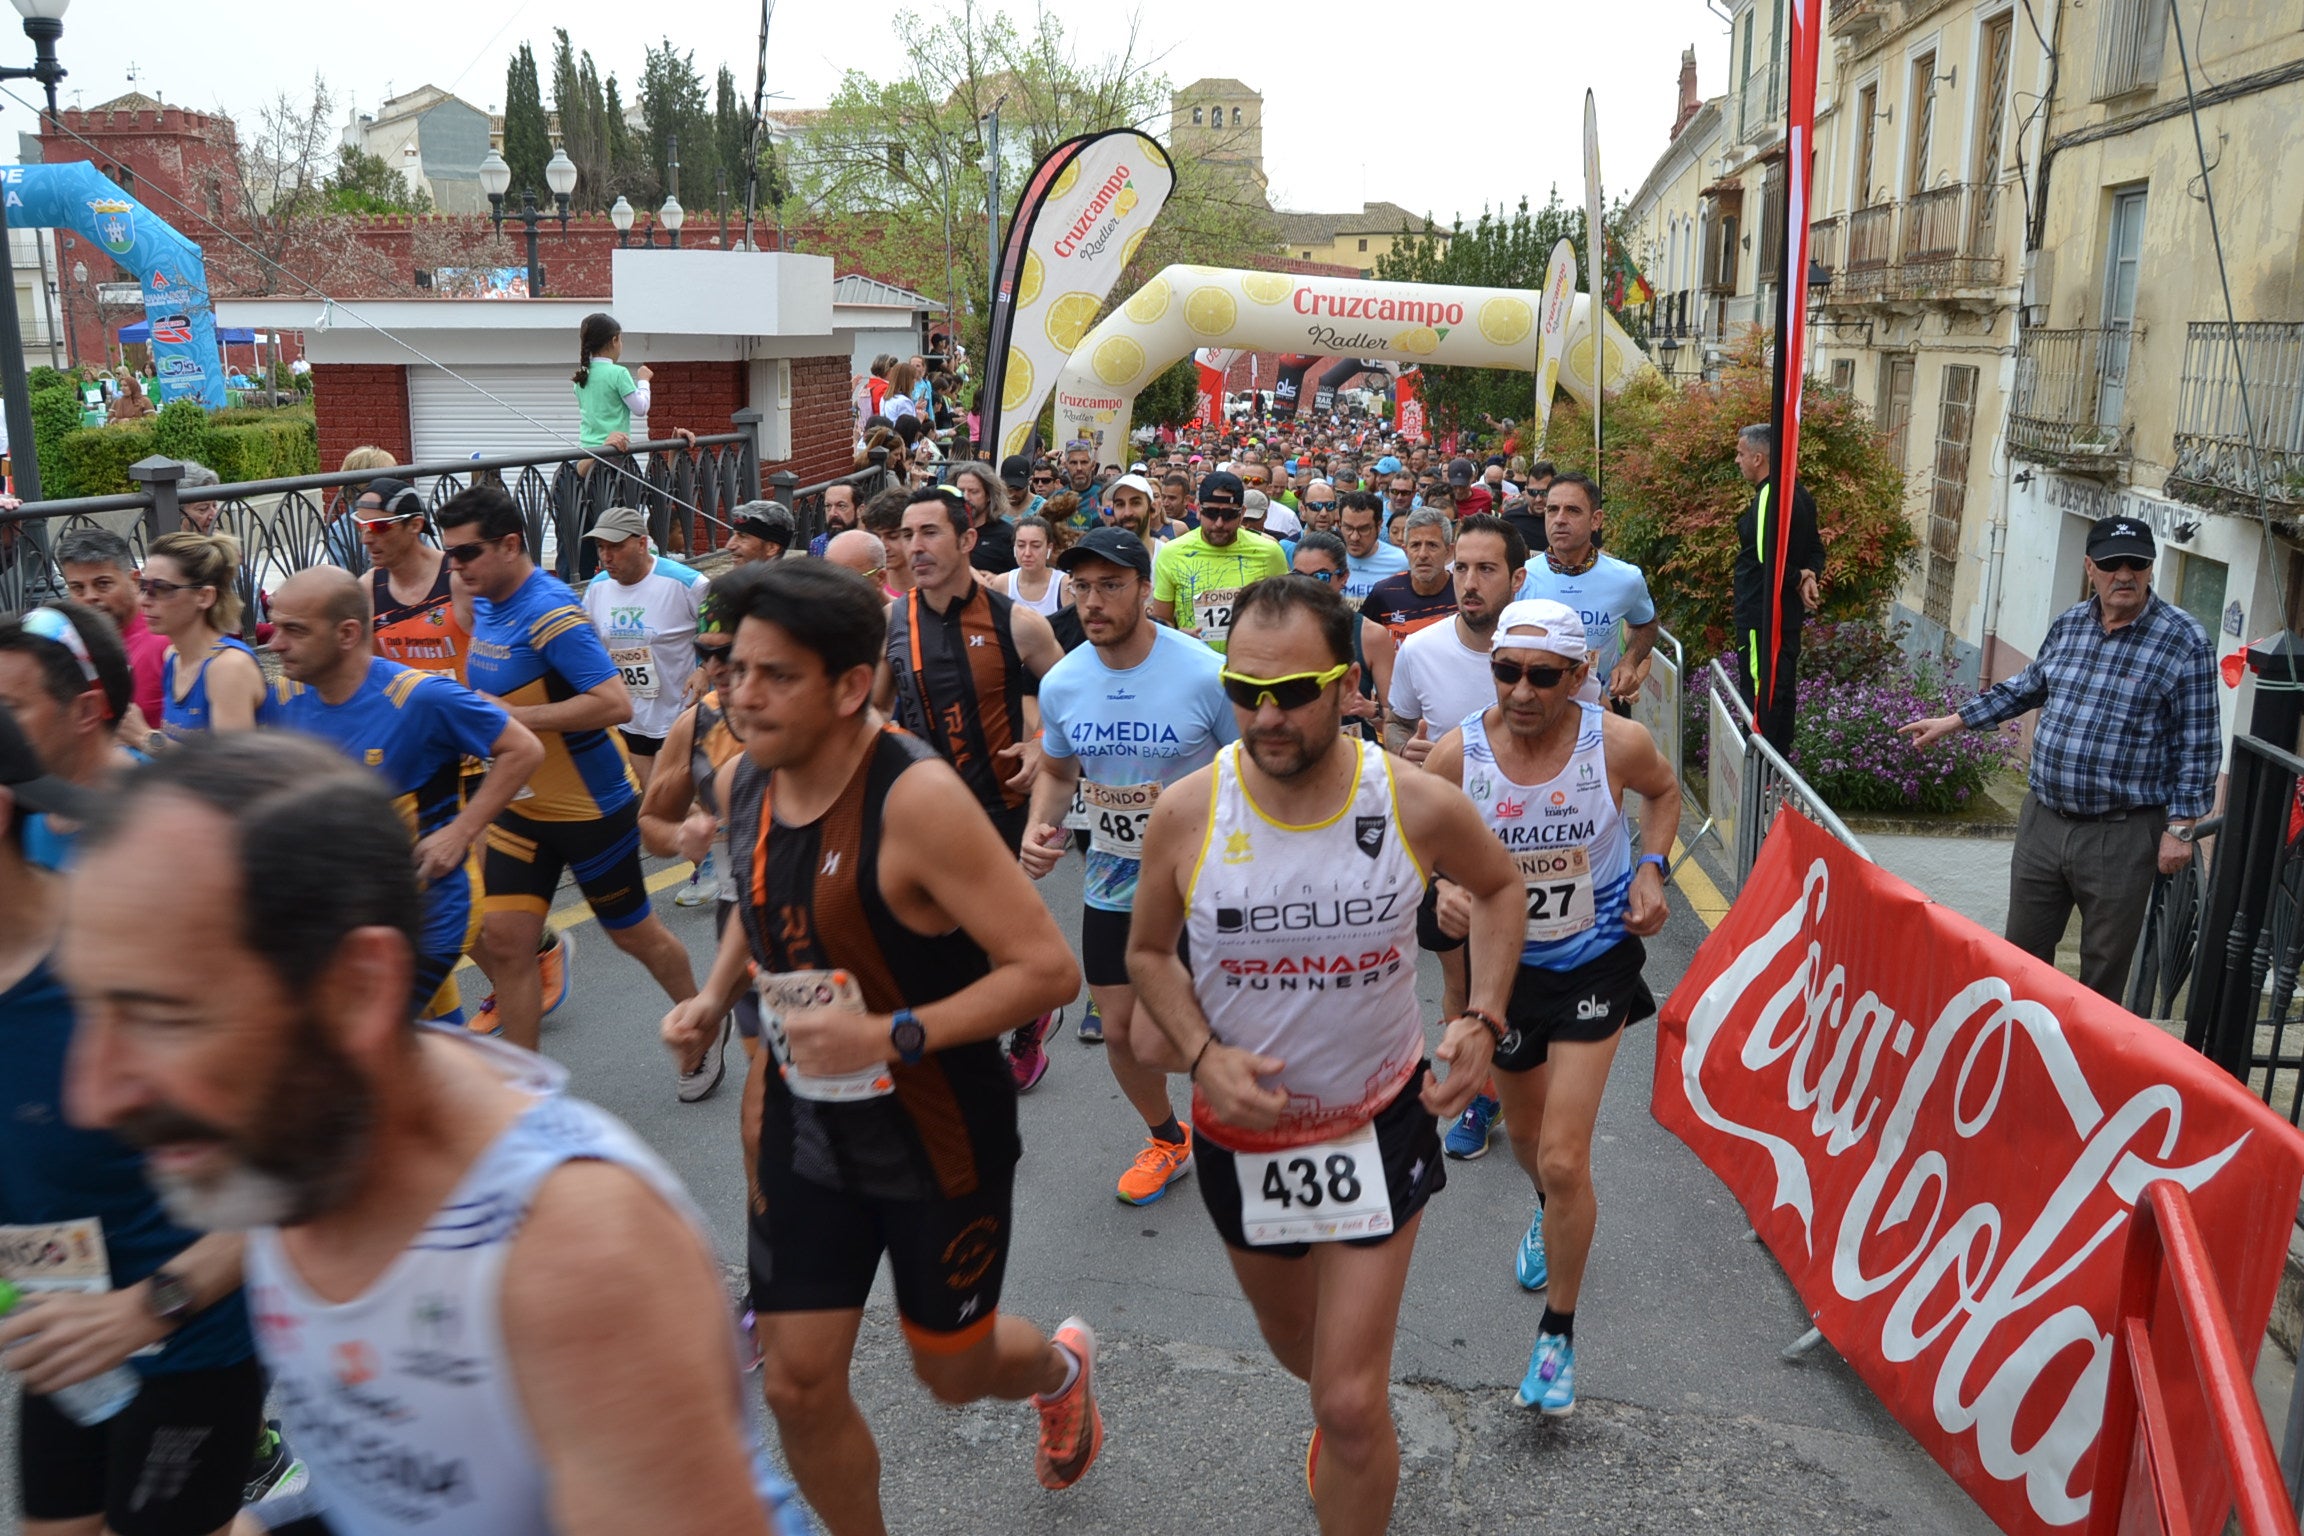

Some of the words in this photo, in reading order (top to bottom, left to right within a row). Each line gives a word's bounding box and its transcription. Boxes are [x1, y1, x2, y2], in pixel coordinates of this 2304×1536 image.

[1053, 164, 1130, 258] Cruzcampo
[1080, 217, 1120, 261] Radler
[1293, 286, 1464, 328] Cruzcampo
[1308, 324, 1390, 351] Radler
[1060, 391, 1123, 411] Cruzcampo
[1063, 408, 1094, 423] Radler
[2060, 481, 2109, 519] DESPENSA
[1142, 746, 1180, 758] BAZA
[1496, 796, 1524, 818] als
[1491, 819, 1596, 845] ARACENA
[1219, 945, 1401, 975] GRANADA
[1226, 960, 1401, 991] RUNNERS
[1577, 994, 1611, 1020] als
[1262, 1154, 1362, 1209] 438
